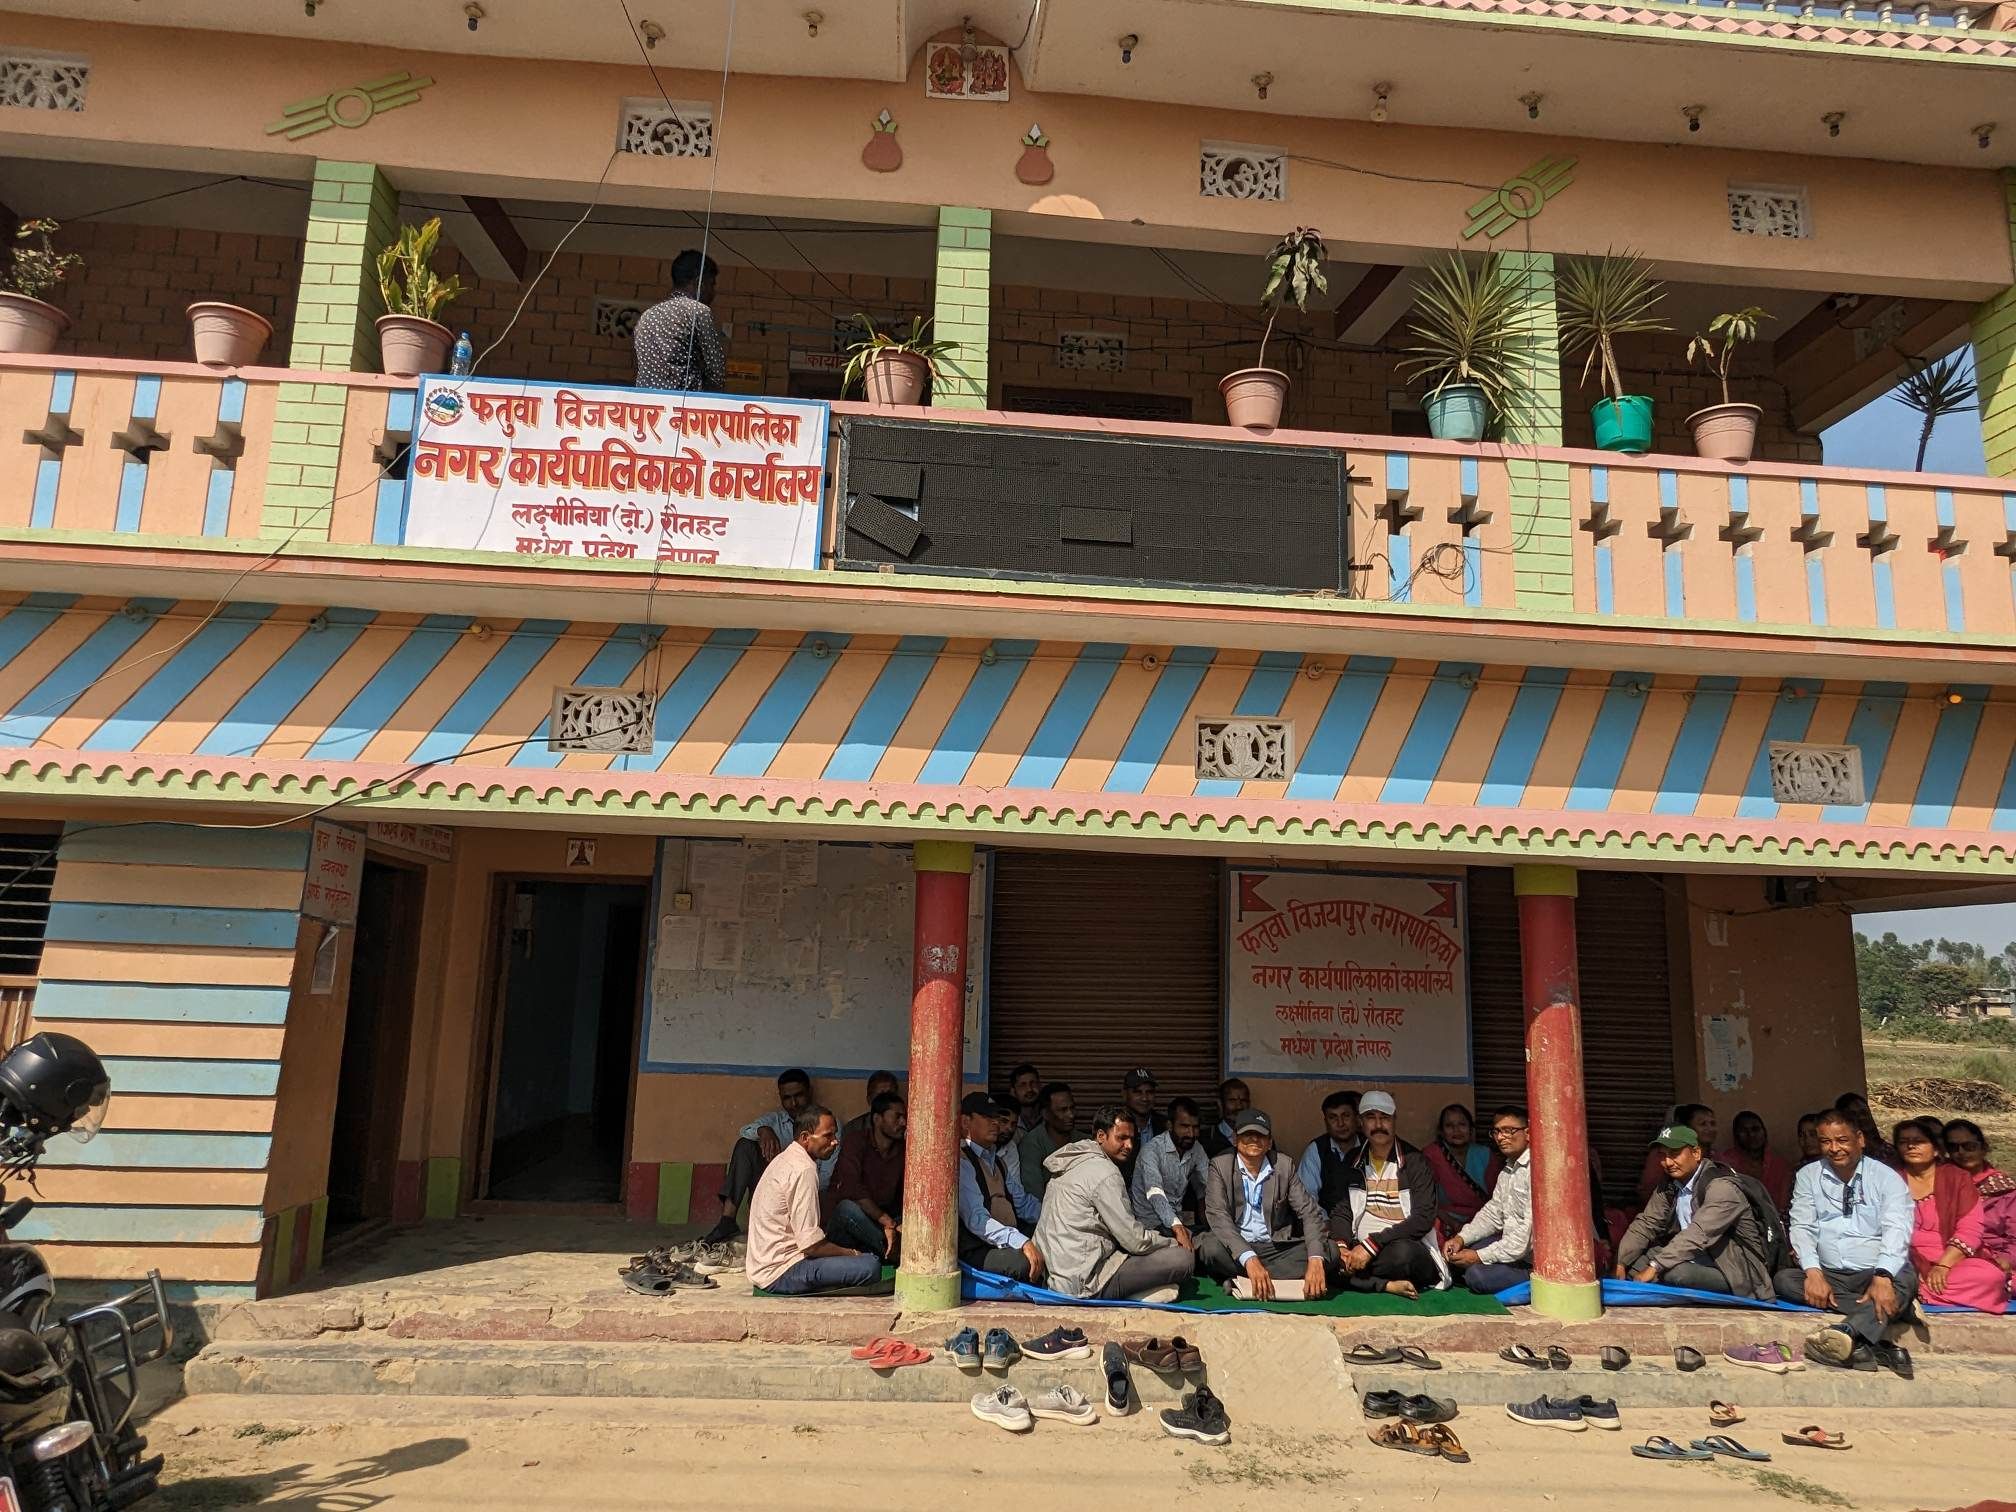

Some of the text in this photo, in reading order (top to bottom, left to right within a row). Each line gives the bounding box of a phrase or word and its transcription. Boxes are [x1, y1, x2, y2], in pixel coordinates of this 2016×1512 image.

[467, 392, 542, 438] फतुवा
[554, 390, 664, 443] विजयपुर
[670, 403, 802, 448] नगरपालिका
[414, 437, 822, 504] नगर कार्यपालिकाको कार्यालय
[1236, 898, 1462, 968] फतुवा विजयपुर नगरपालिका
[1251, 960, 1454, 996] नगर कार्यपालिकाको कार्यालय
[1279, 1030, 1318, 1058] मधेश
